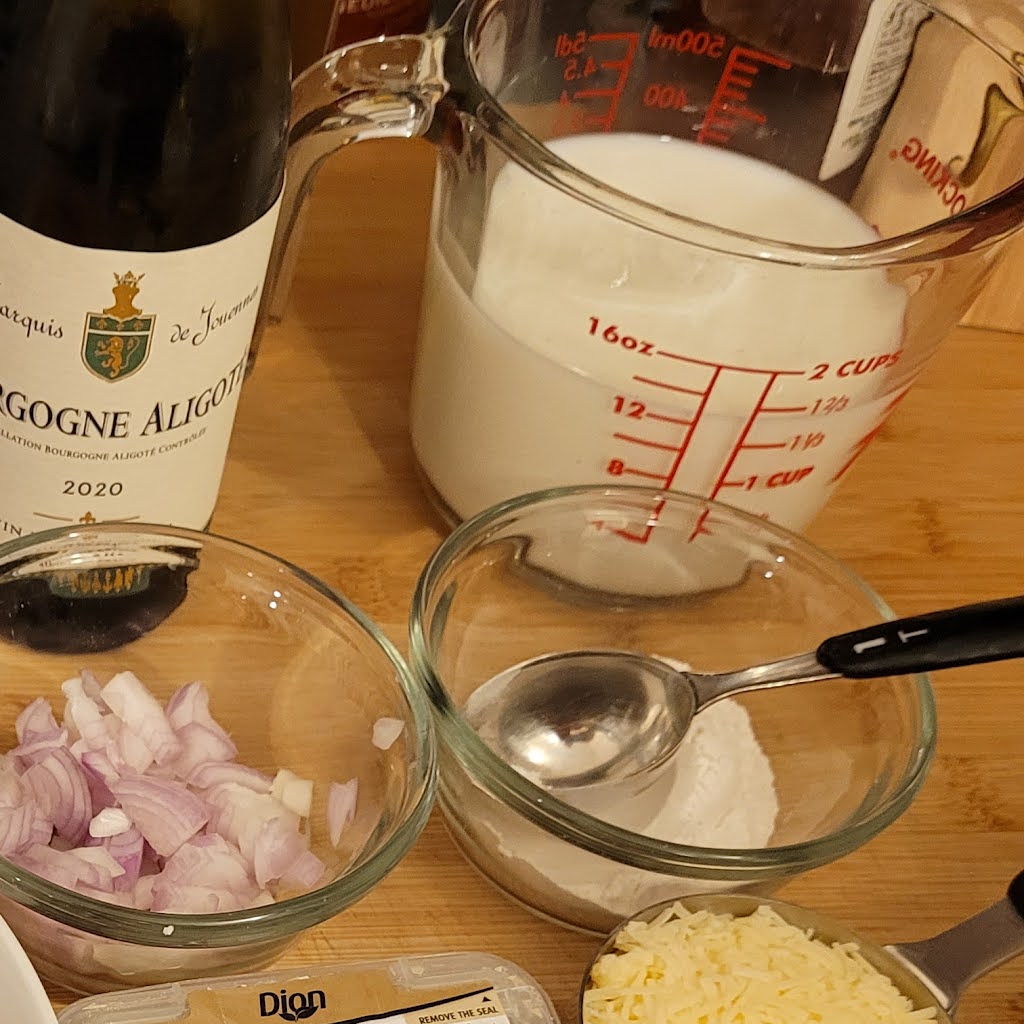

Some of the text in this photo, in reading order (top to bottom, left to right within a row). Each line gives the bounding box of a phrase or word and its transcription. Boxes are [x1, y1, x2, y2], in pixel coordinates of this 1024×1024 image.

[170, 324, 190, 343] de
[588, 316, 655, 357] 16oz
[808, 350, 904, 381] 2 CUPS
[613, 395, 646, 420] 12
[45, 445, 109, 461] BOURGOGNE
[606, 459, 624, 477] 8
[766, 465, 815, 488] CUP
[62, 480, 123, 497] 2020
[259, 989, 327, 1017] Dion
[418, 1005, 499, 1024] REMOVE THE SEAL
